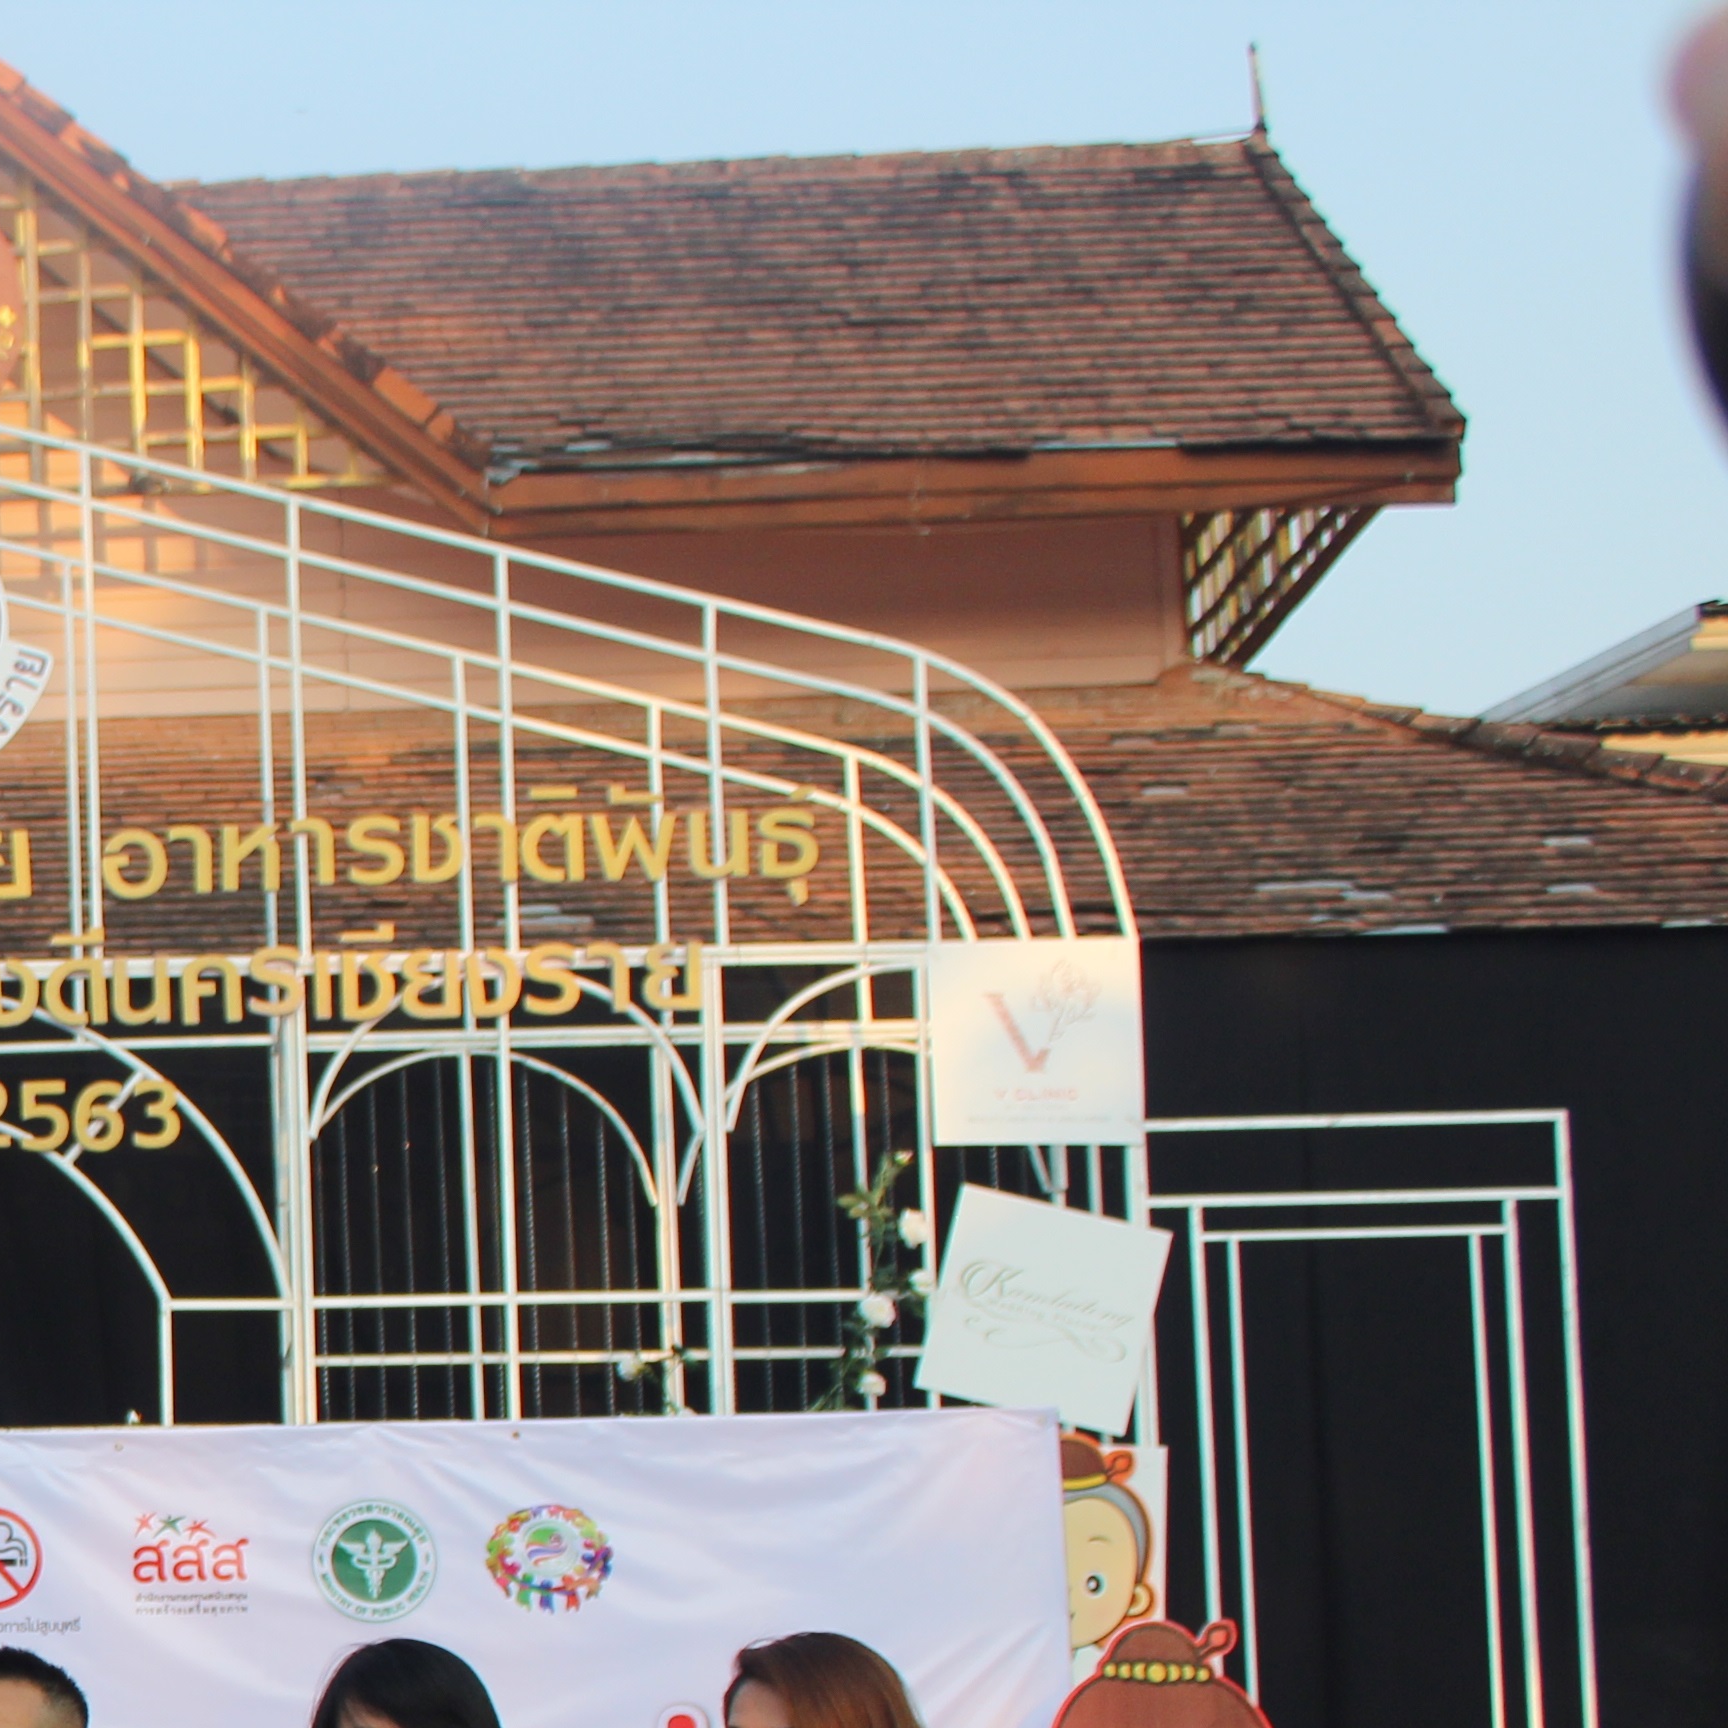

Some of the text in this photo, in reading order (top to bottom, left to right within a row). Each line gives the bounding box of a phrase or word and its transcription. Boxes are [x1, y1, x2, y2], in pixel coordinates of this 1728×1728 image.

[102, 785, 820, 907] อาหารชาติพันธุ์
[132, 1537, 250, 1584] สสส
